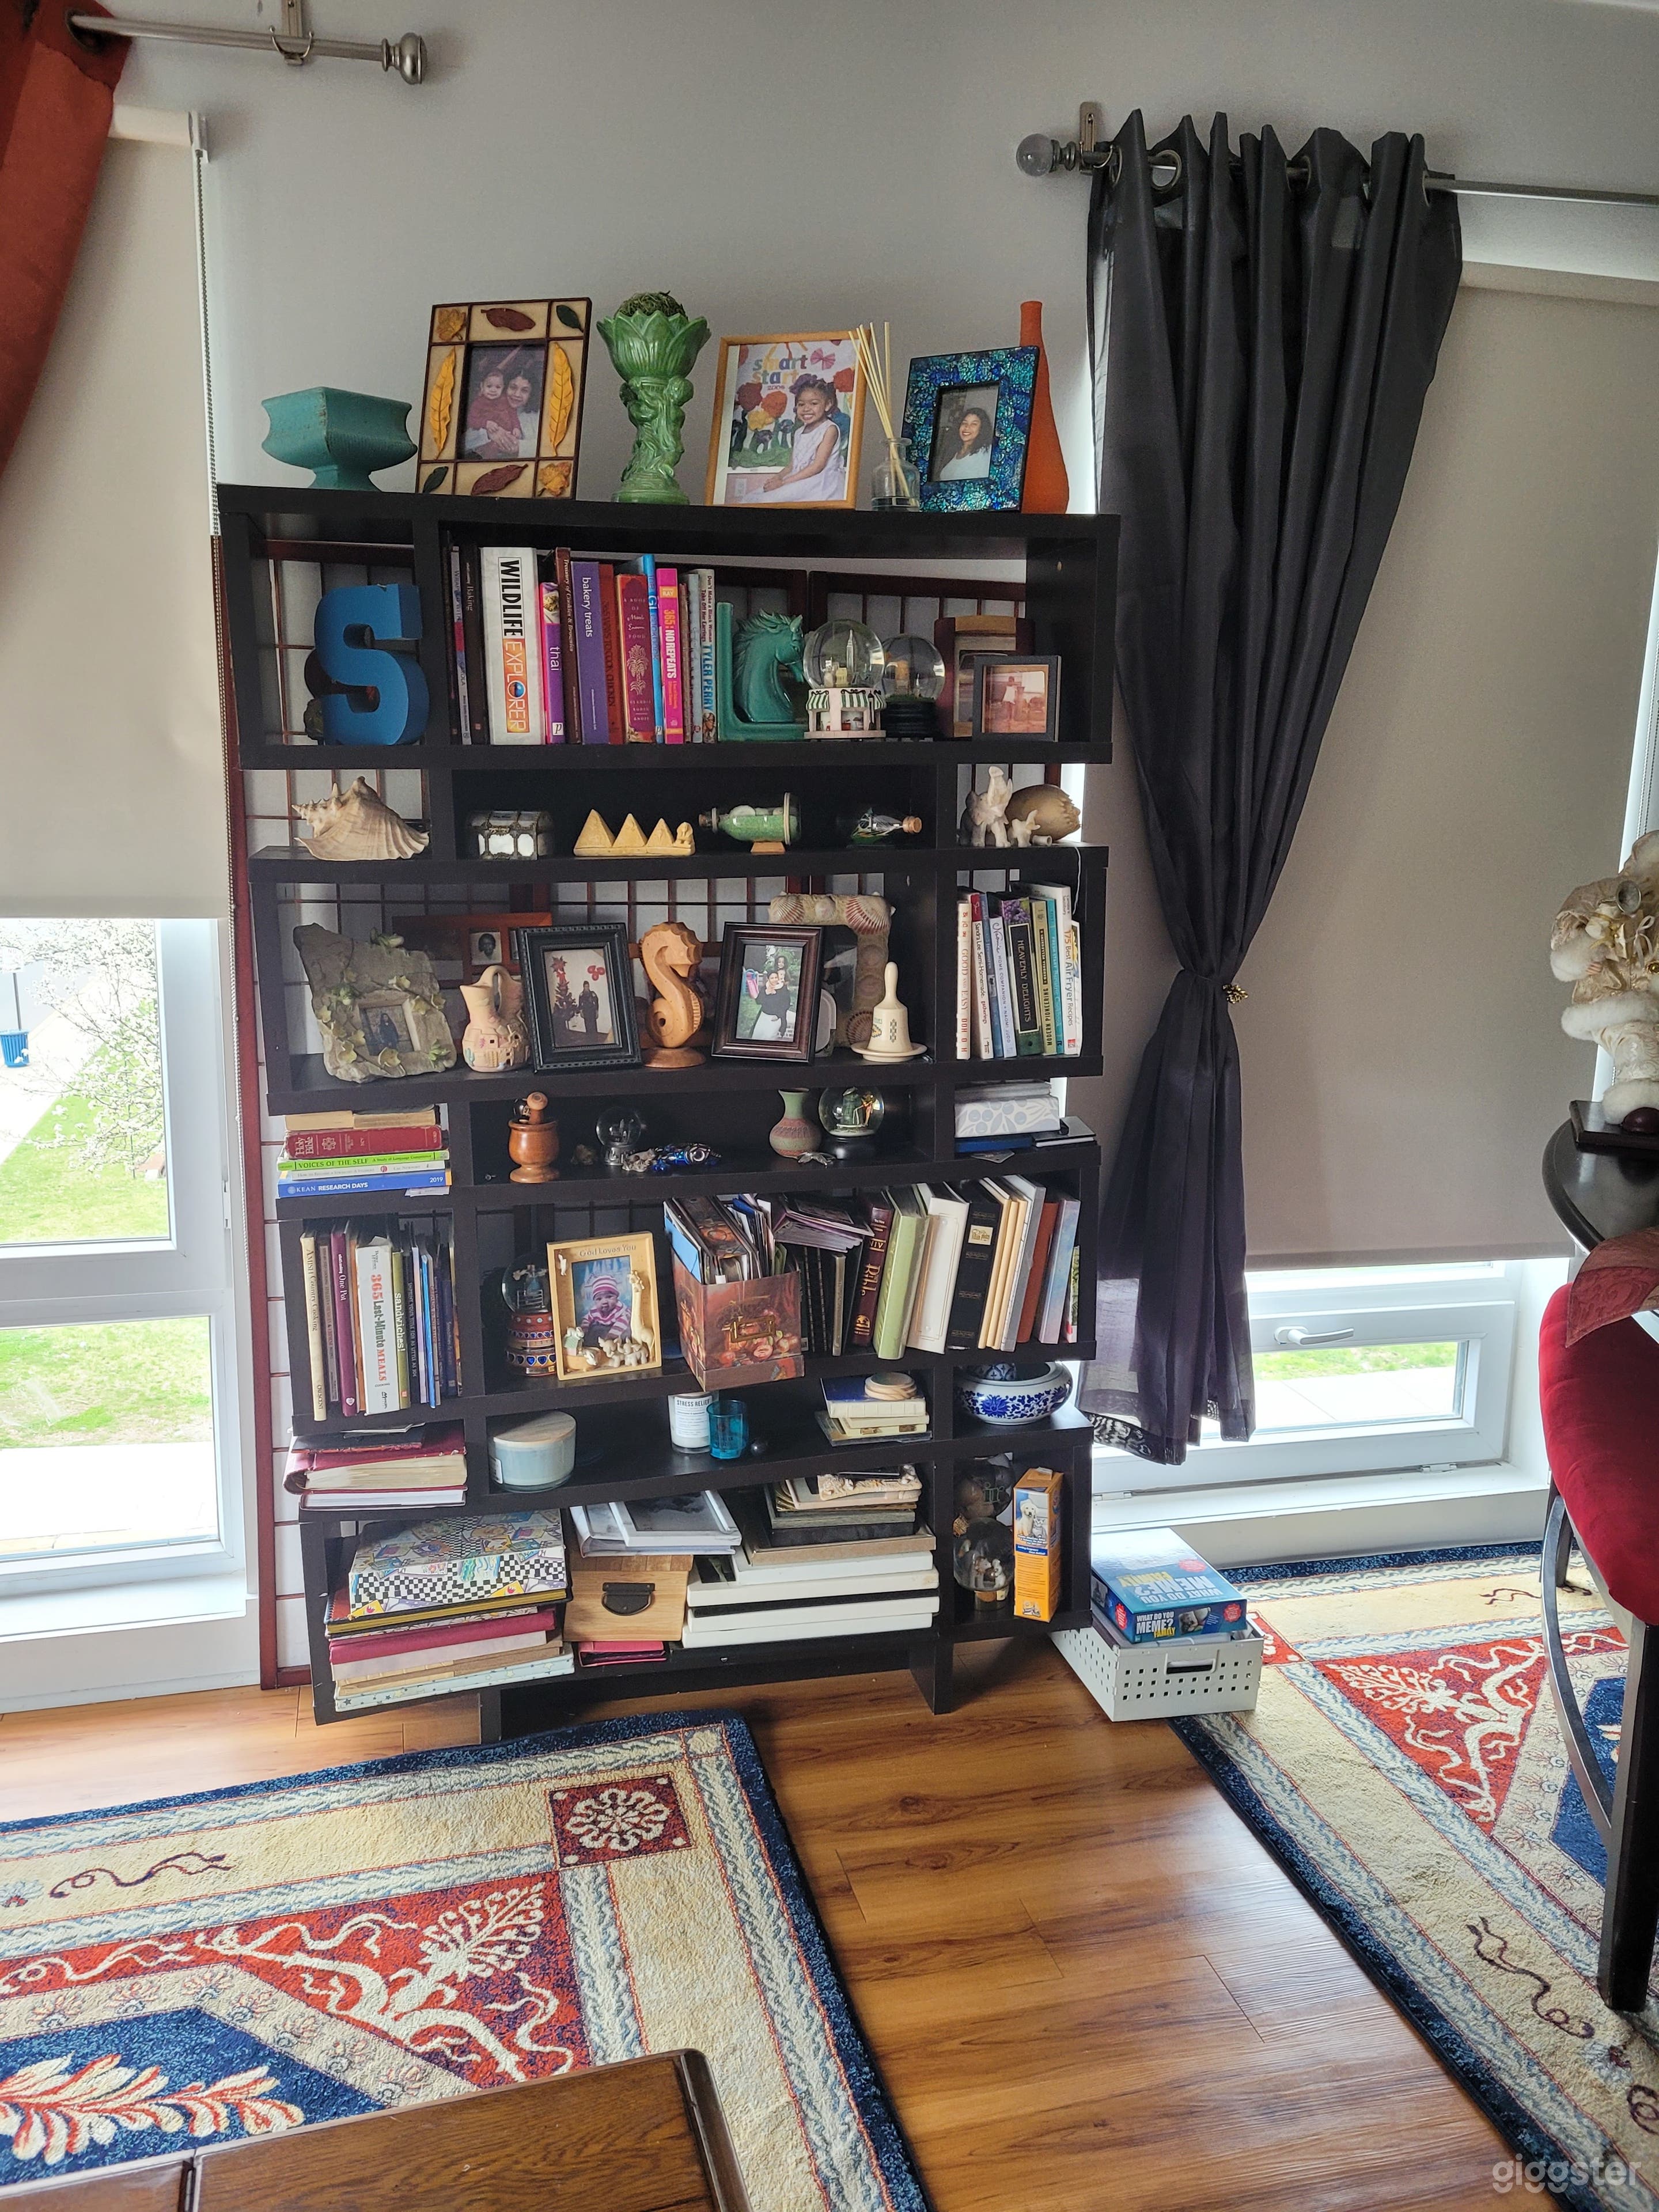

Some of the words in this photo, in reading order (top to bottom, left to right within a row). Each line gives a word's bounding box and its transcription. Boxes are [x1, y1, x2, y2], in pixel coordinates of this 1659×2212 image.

[753, 355, 808, 371] smart
[563, 558, 571, 584] Treasury
[466, 586, 474, 611] Baking
[499, 560, 522, 637] WILDLIFE
[581, 577, 592, 609] bakery
[649, 595, 657, 609] GI
[584, 612, 593, 637] treats
[605, 641, 612, 650] TO
[315, 584, 430, 745] S
[550, 646, 561, 671] thai
[702, 644, 713, 676] TYLER
[505, 641, 528, 731] EXPLORER
[607, 675, 615, 706] CHICKEN
[703, 679, 714, 711] PERRY
[975, 923, 983, 940] Sandra
[1017, 940, 1028, 980] HEAVENLY
[1065, 962, 1073, 976] Air
[1065, 978, 1074, 1001] Fryer
[1021, 983, 1032, 1022] DELIGHTS
[1066, 1003, 1074, 1026] Recipes
[295, 1137, 306, 1155] Holy
[305, 1137, 314, 1154] Bible
[318, 1183, 351, 1191] RESEARCH
[579, 1248, 597, 1257] God
[599, 1246, 620, 1254] Loves
[309, 1275, 318, 1302] Country
[338, 1274, 347, 1289] One
[372, 1274, 383, 1300] 365
[862, 1263, 881, 1296] Bible
[339, 1290, 347, 1301] Pot
[310, 1304, 319, 1331] Cooking
[373, 1300, 386, 1348] Last-Minute
[394, 1293, 408, 1351] sandwiches!
[377, 1349, 388, 1381] MEALS
[695, 1399, 710, 1407] RELIEF
[1134, 1575, 1216, 1596] MEME?
[1166, 1592, 1186, 1601] DO
[1186, 1588, 1224, 1598] WHAT
[1139, 1594, 1165, 1604] YOU
[1136, 1618, 1175, 1634] MEME?
[1137, 1614, 1154, 1622] WHAT
[1154, 1627, 1176, 1638] FAMILY
